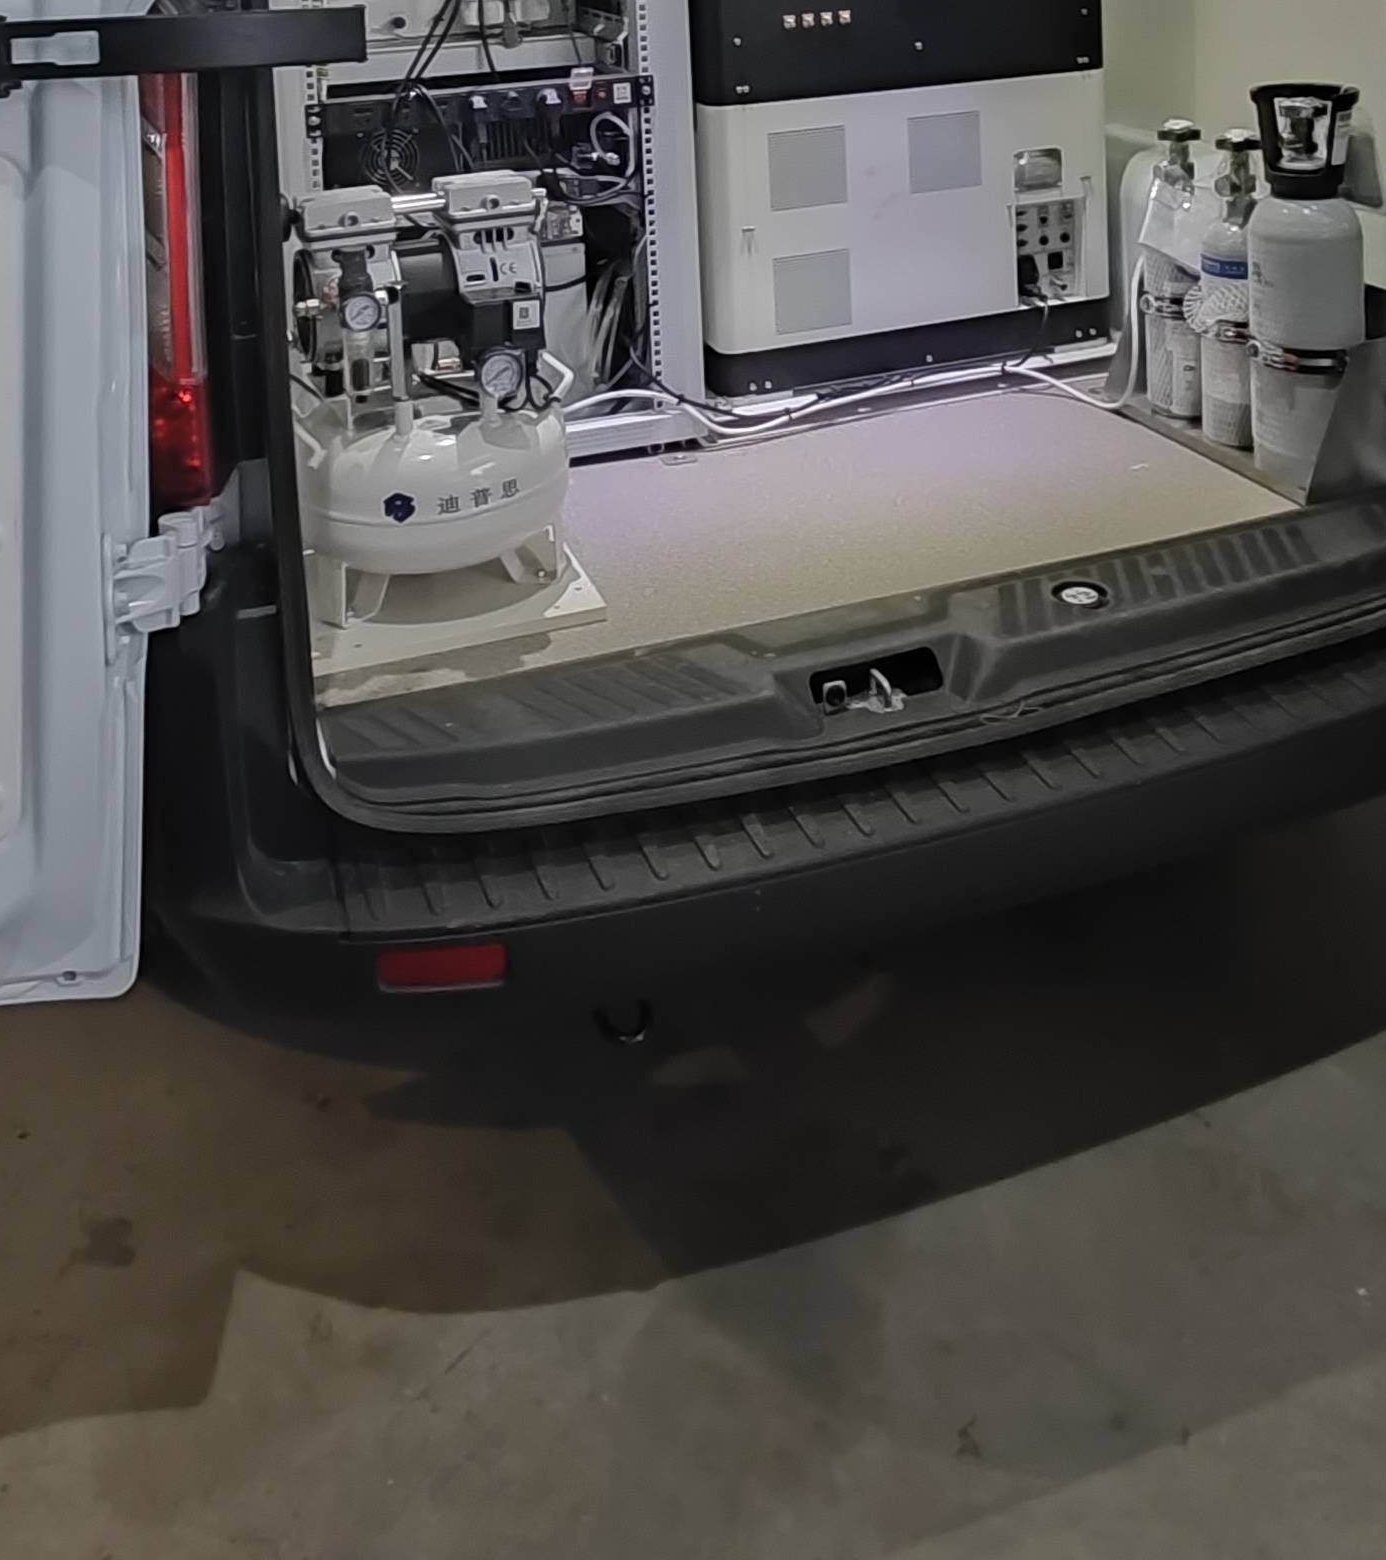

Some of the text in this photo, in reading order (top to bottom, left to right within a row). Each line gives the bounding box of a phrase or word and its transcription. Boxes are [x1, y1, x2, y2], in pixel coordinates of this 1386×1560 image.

[499, 261, 518, 276] CE
[437, 478, 520, 515] 迪普思
